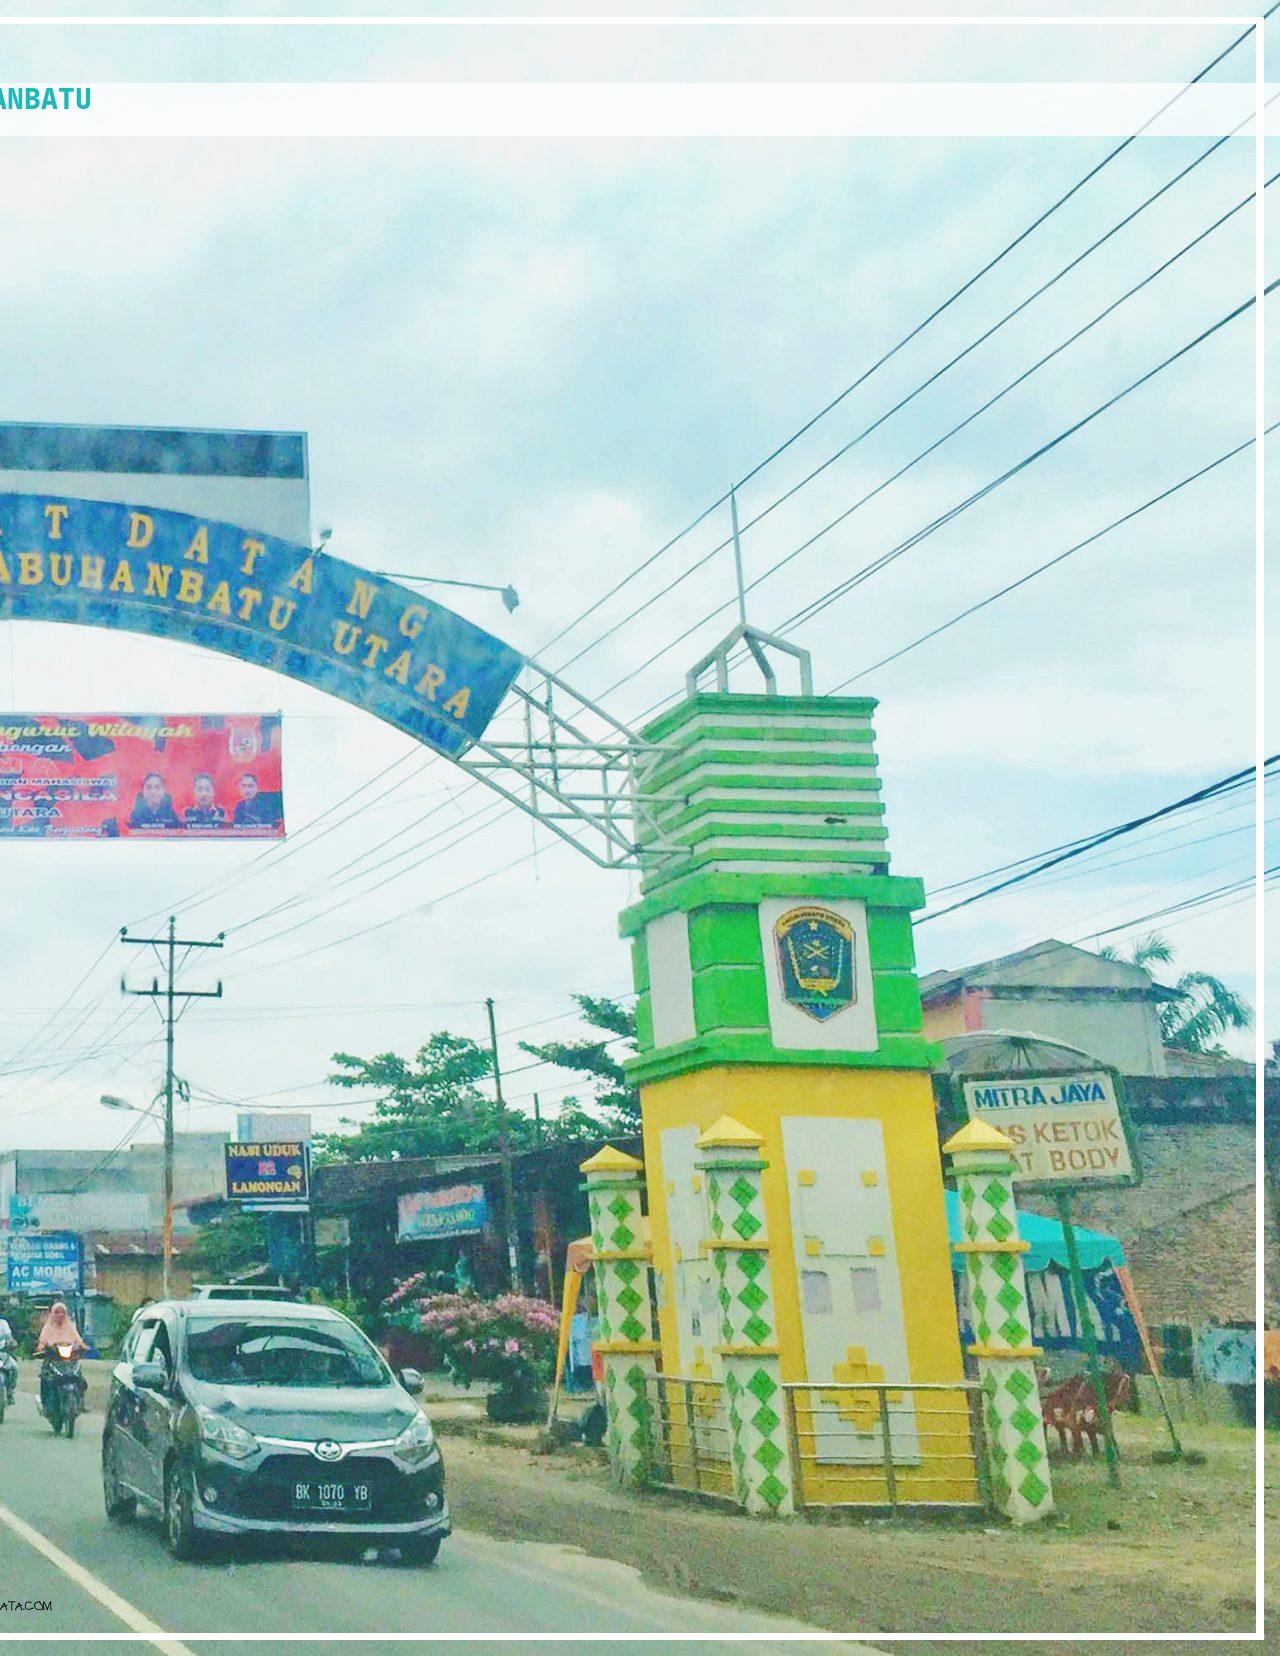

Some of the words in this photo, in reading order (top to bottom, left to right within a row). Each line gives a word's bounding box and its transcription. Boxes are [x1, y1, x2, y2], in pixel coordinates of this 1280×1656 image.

[127, 511, 428, 640] DATANG
[330, 621, 473, 719] UTARA
[88, 723, 194, 740] Wilayah
[974, 1086, 1048, 1109] MITRA
[1051, 1082, 1106, 1105] JAYA
[1034, 1117, 1119, 1143] KETOK
[228, 1144, 260, 1157] NASI
[263, 1143, 302, 1157] UDUK
[1049, 1147, 1119, 1172] BODY
[232, 1181, 301, 1194] LAMONGAN
[12, 1265, 29, 1278] AC
[295, 1484, 311, 1500] BK
[317, 1484, 345, 1500] 1070
[353, 1485, 368, 1500] YB
